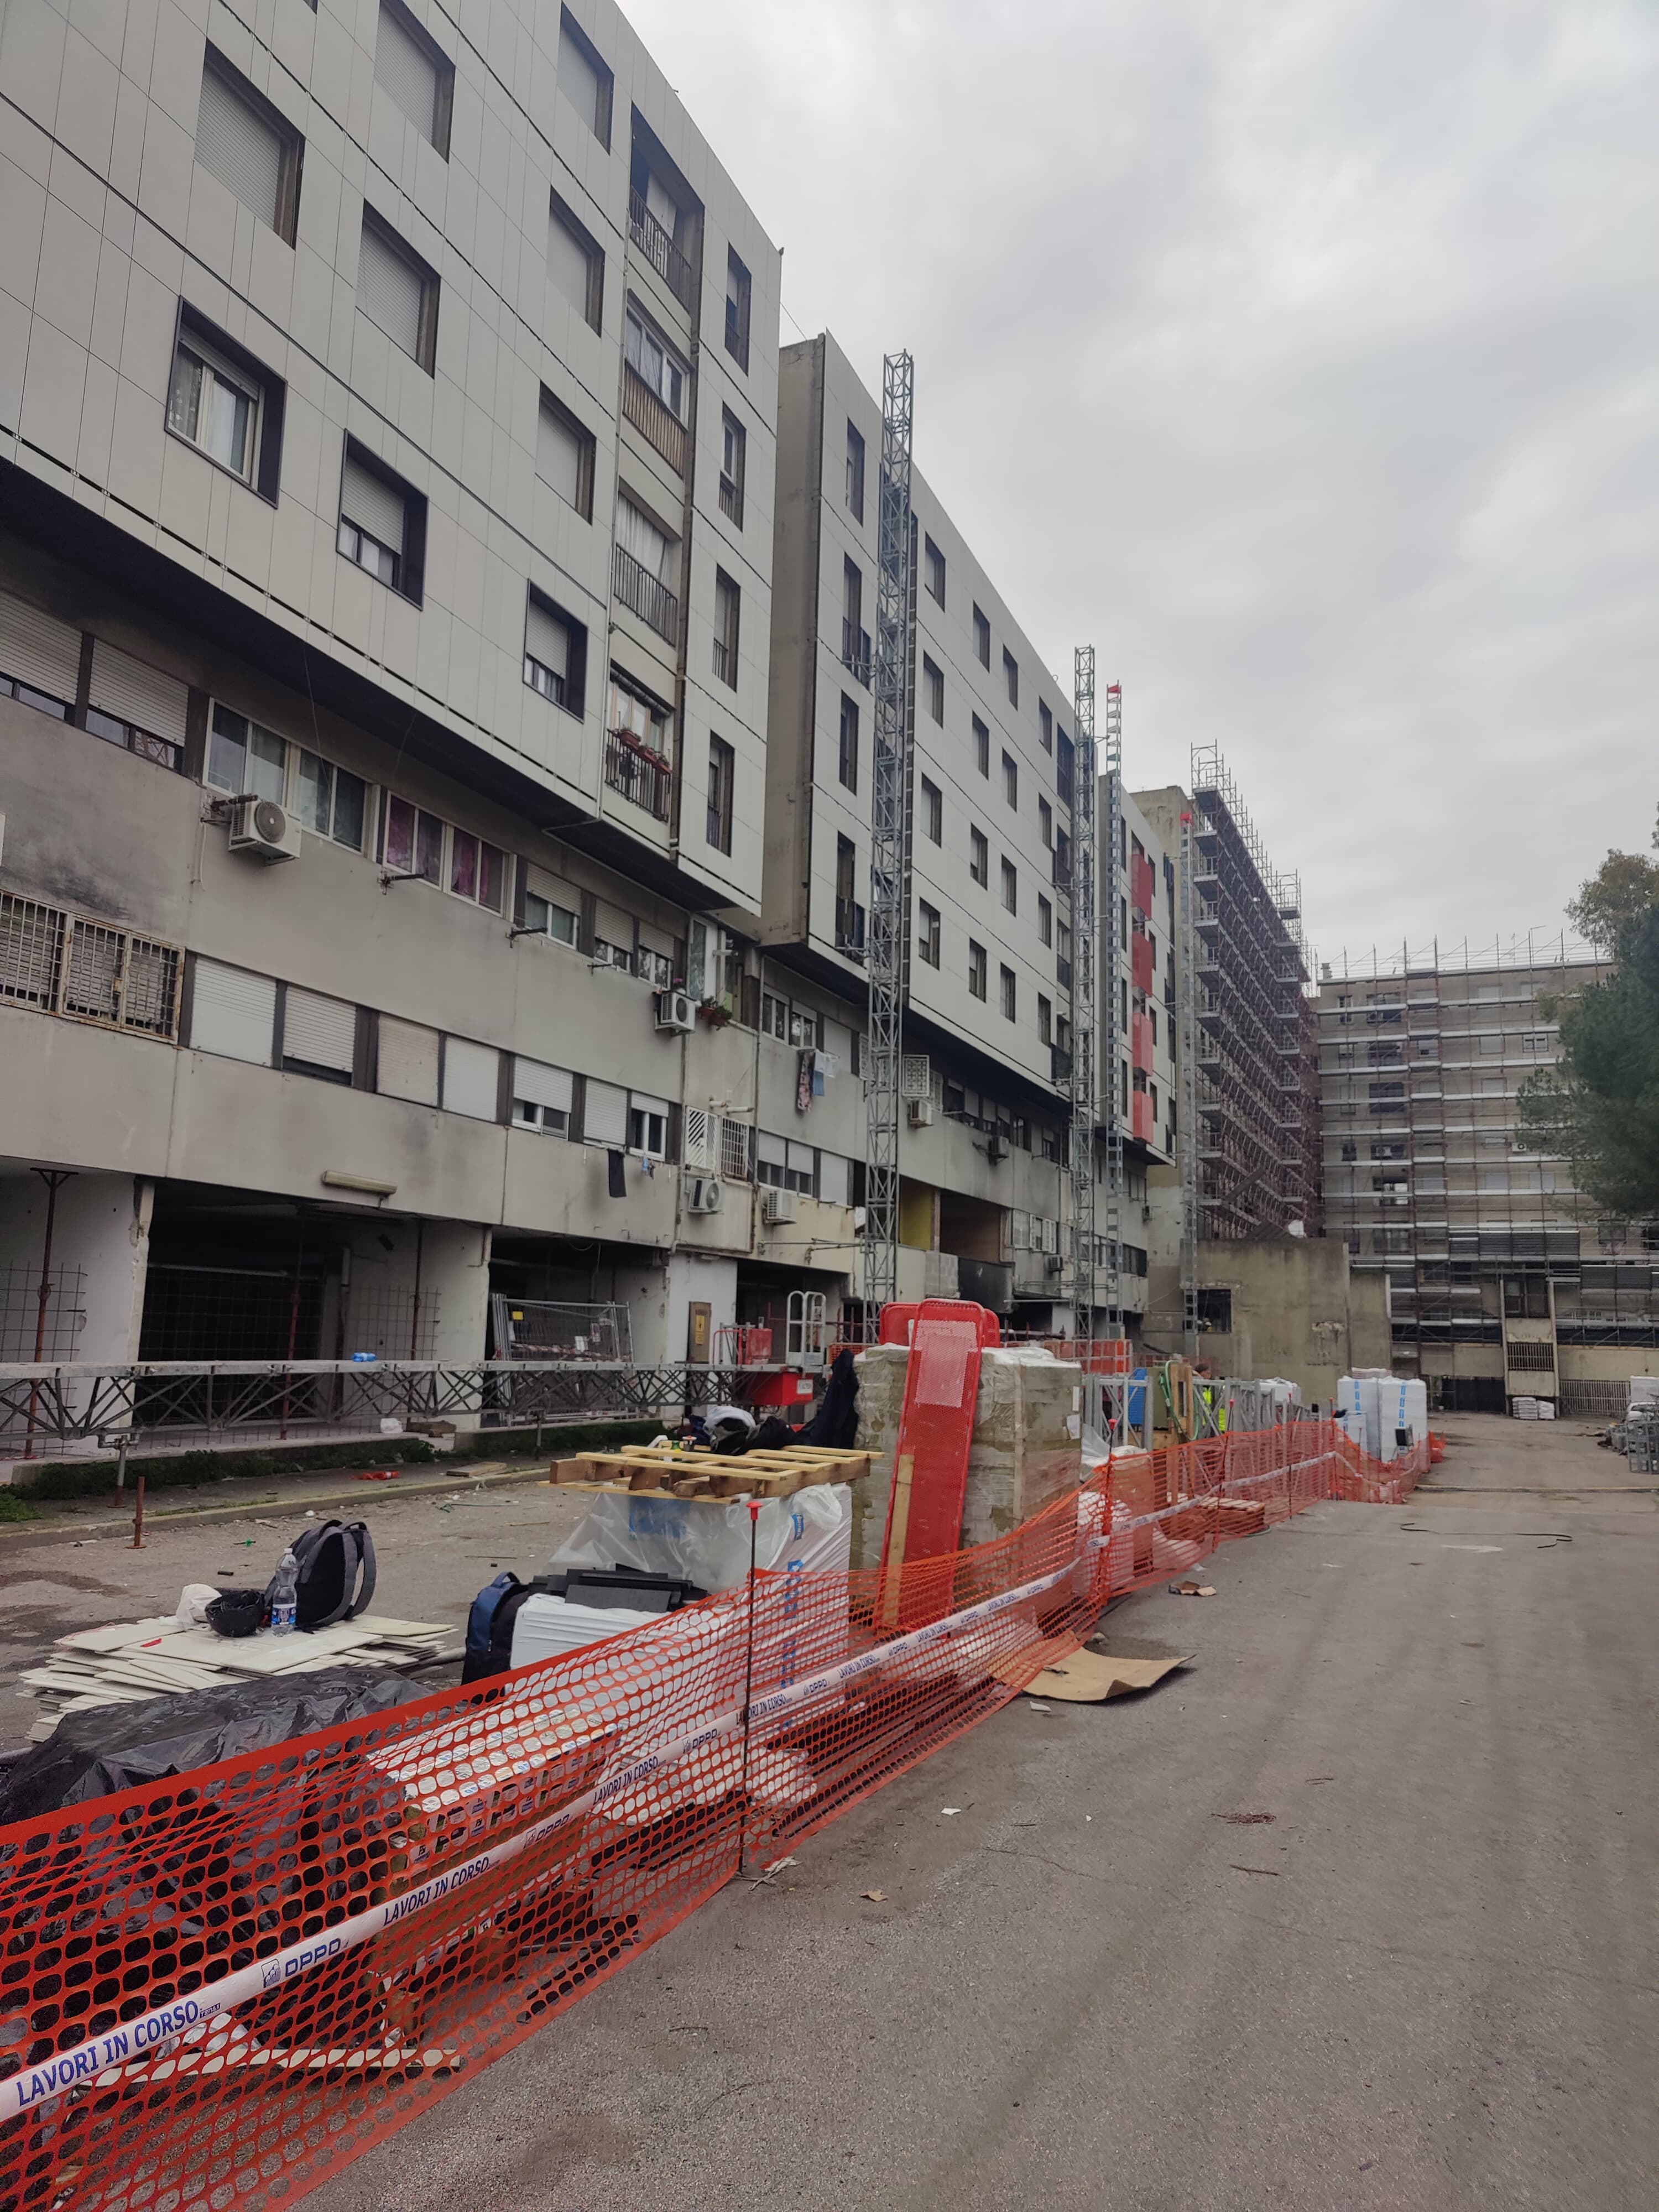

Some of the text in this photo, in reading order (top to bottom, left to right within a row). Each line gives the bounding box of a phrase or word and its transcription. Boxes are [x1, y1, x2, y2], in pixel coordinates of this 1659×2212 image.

[837, 1662, 856, 1678] LAVORI
[862, 1654, 876, 1668] CORSO
[810, 1678, 828, 1693] OPPO
[736, 1694, 786, 1725] LAORI IN CORSO
[692, 1728, 718, 1749] OPPO
[593, 1756, 658, 1806] LAVORI IN CORSO
[535, 1813, 570, 1842] OPPO
[383, 1856, 489, 1926] LAVORI IN CORSO
[285, 1938, 341, 1977] OPPO
[16, 2000, 221, 2107] LAVORI IN CORSO TENAX
